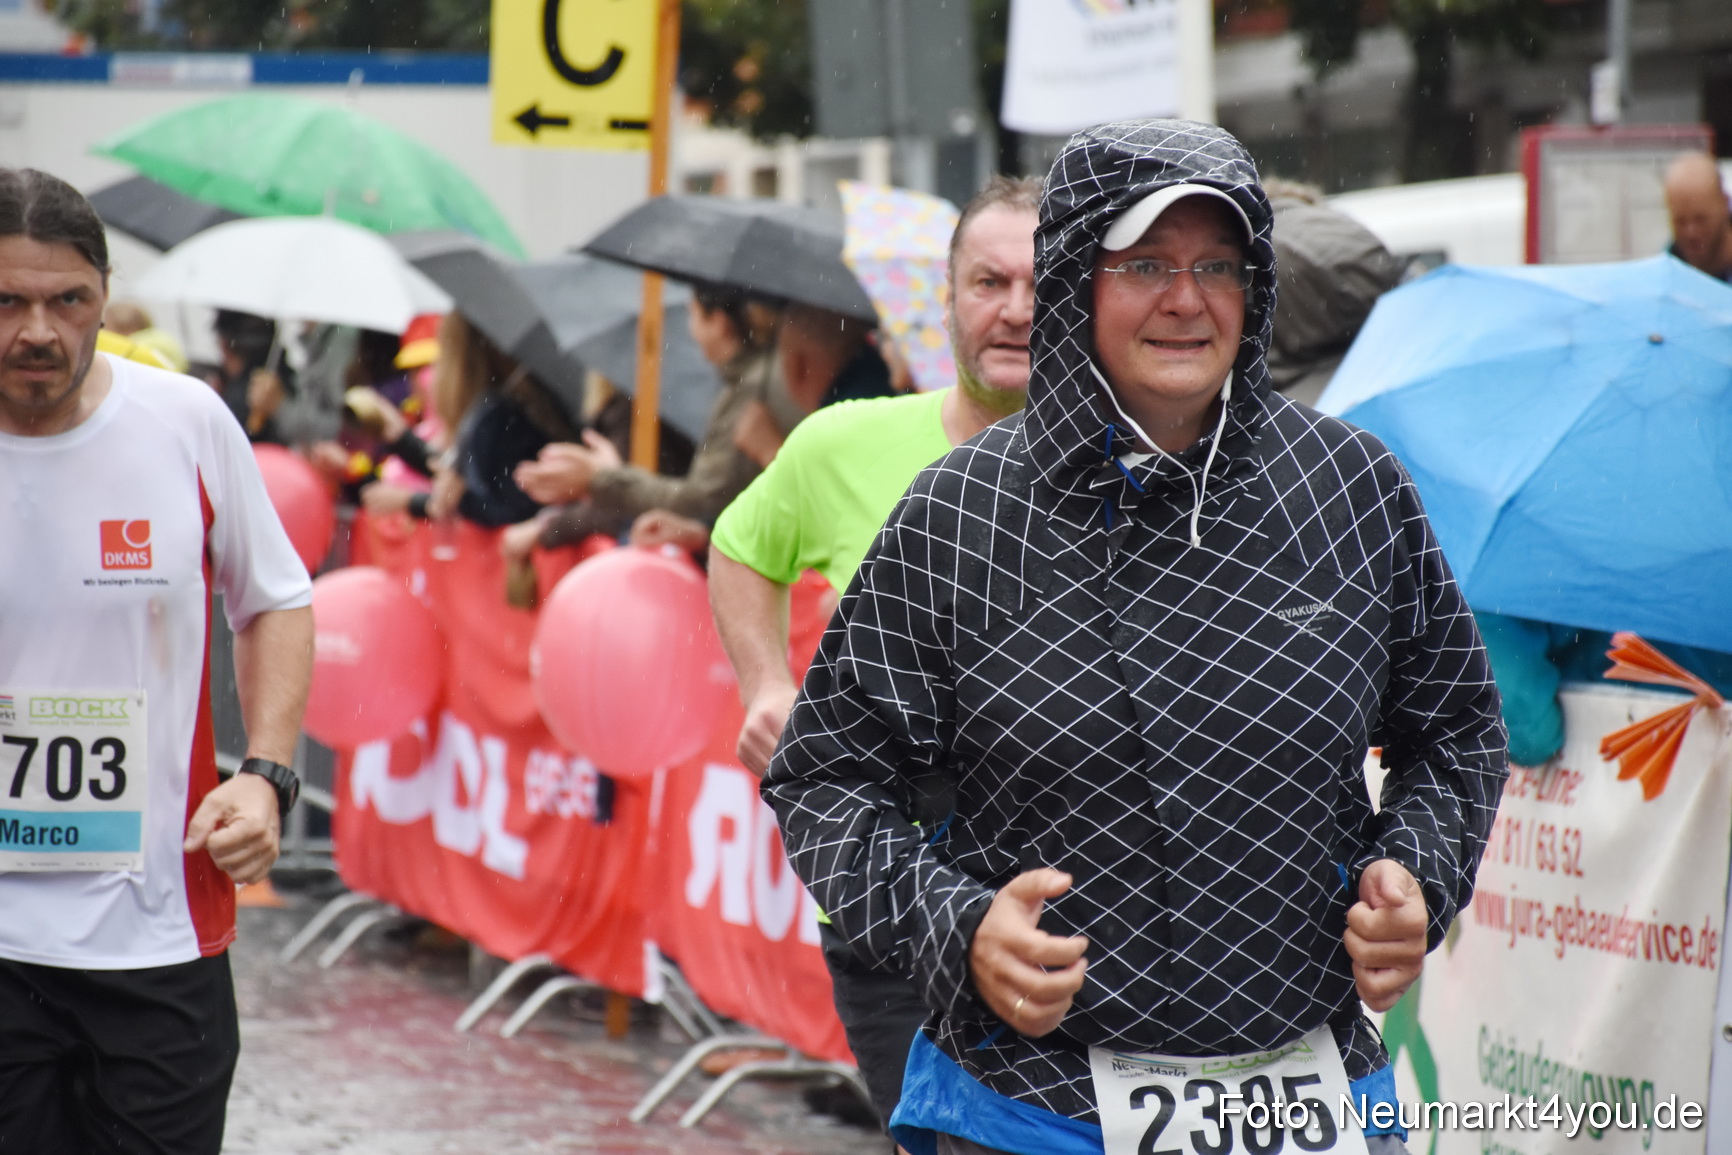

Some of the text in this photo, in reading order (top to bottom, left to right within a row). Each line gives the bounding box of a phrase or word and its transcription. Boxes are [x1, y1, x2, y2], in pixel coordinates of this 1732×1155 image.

[543, 0, 625, 86] C
[104, 551, 149, 567] DKMS
[29, 697, 129, 719] BOCK
[2, 734, 127, 802] 703
[0, 818, 79, 846] Marco
[1536, 824, 1557, 873] 63
[1561, 827, 1585, 878] 52
[1129, 1072, 1338, 1155] 2385
